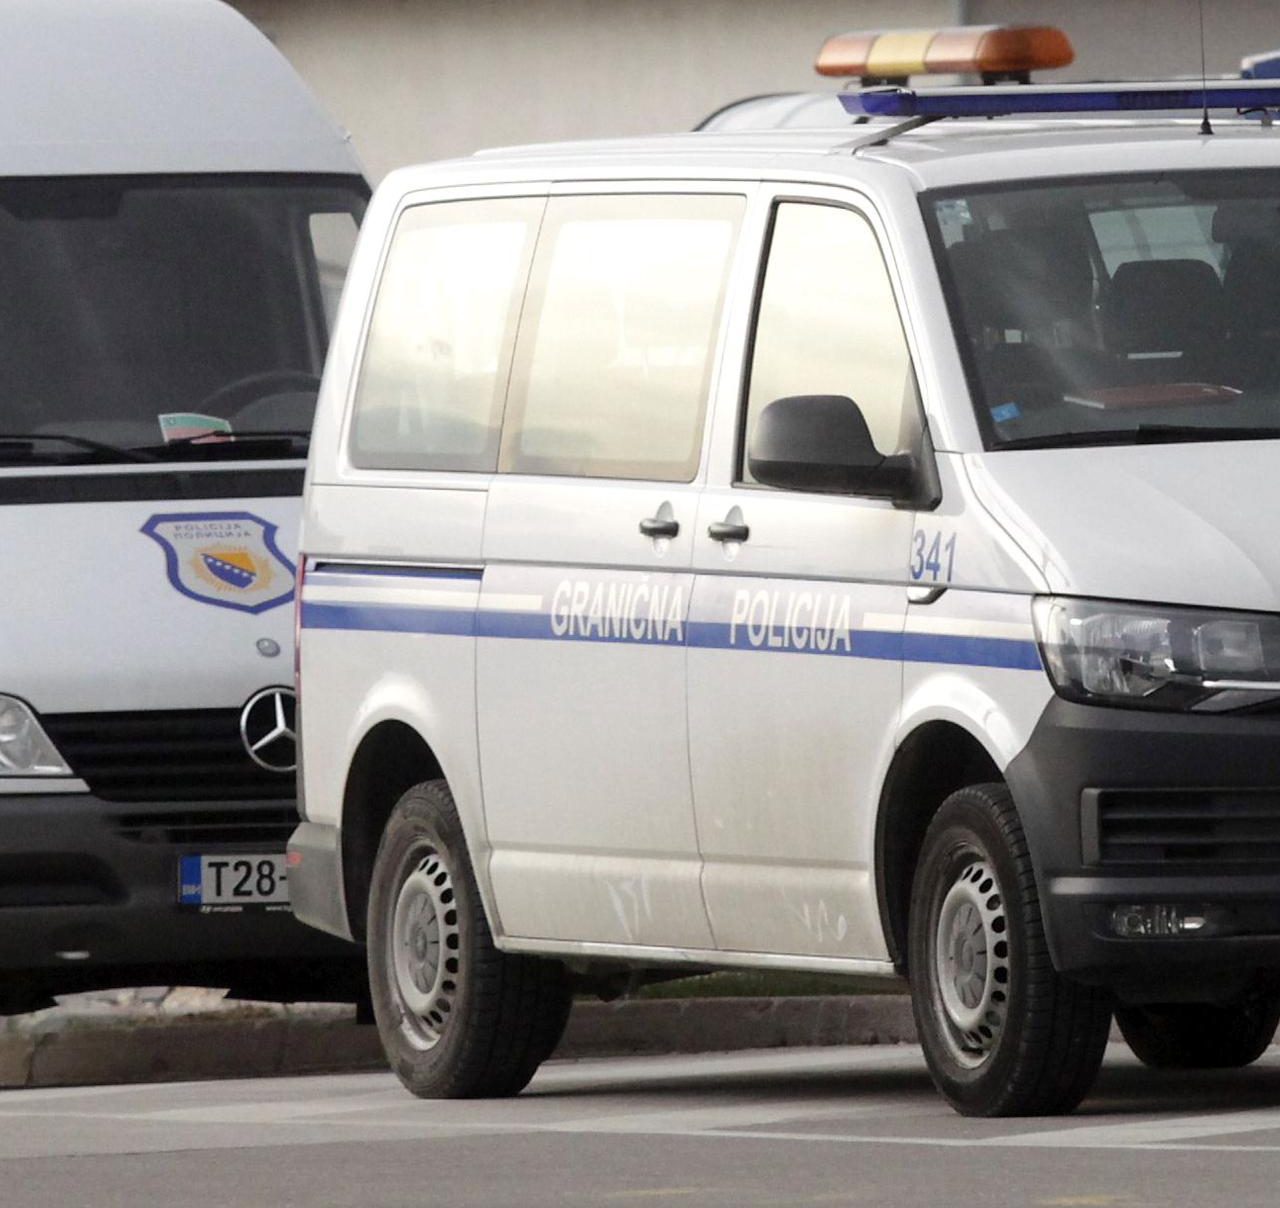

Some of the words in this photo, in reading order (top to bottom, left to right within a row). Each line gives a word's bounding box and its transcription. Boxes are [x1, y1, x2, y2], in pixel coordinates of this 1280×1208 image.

[911, 528, 958, 584] 341
[549, 574, 685, 642] GRANIČNA
[729, 588, 853, 653] POLICIJA
